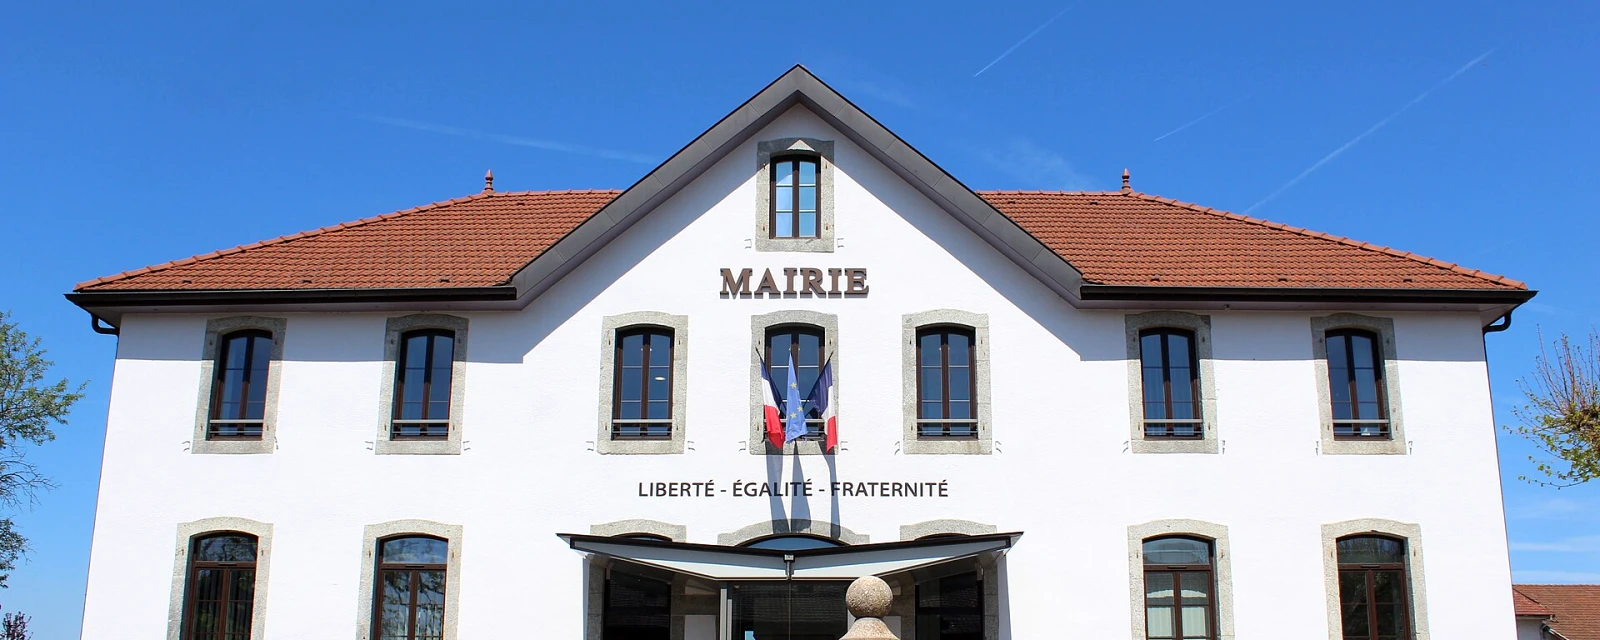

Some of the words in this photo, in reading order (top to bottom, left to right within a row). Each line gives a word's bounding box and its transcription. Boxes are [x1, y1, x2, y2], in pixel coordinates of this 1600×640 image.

[719, 267, 870, 299] MAIRIE
[638, 479, 715, 497] LIBERTÉ
[732, 479, 813, 497] ÉGALITÉ
[830, 479, 949, 497] FRATERNITÉ
